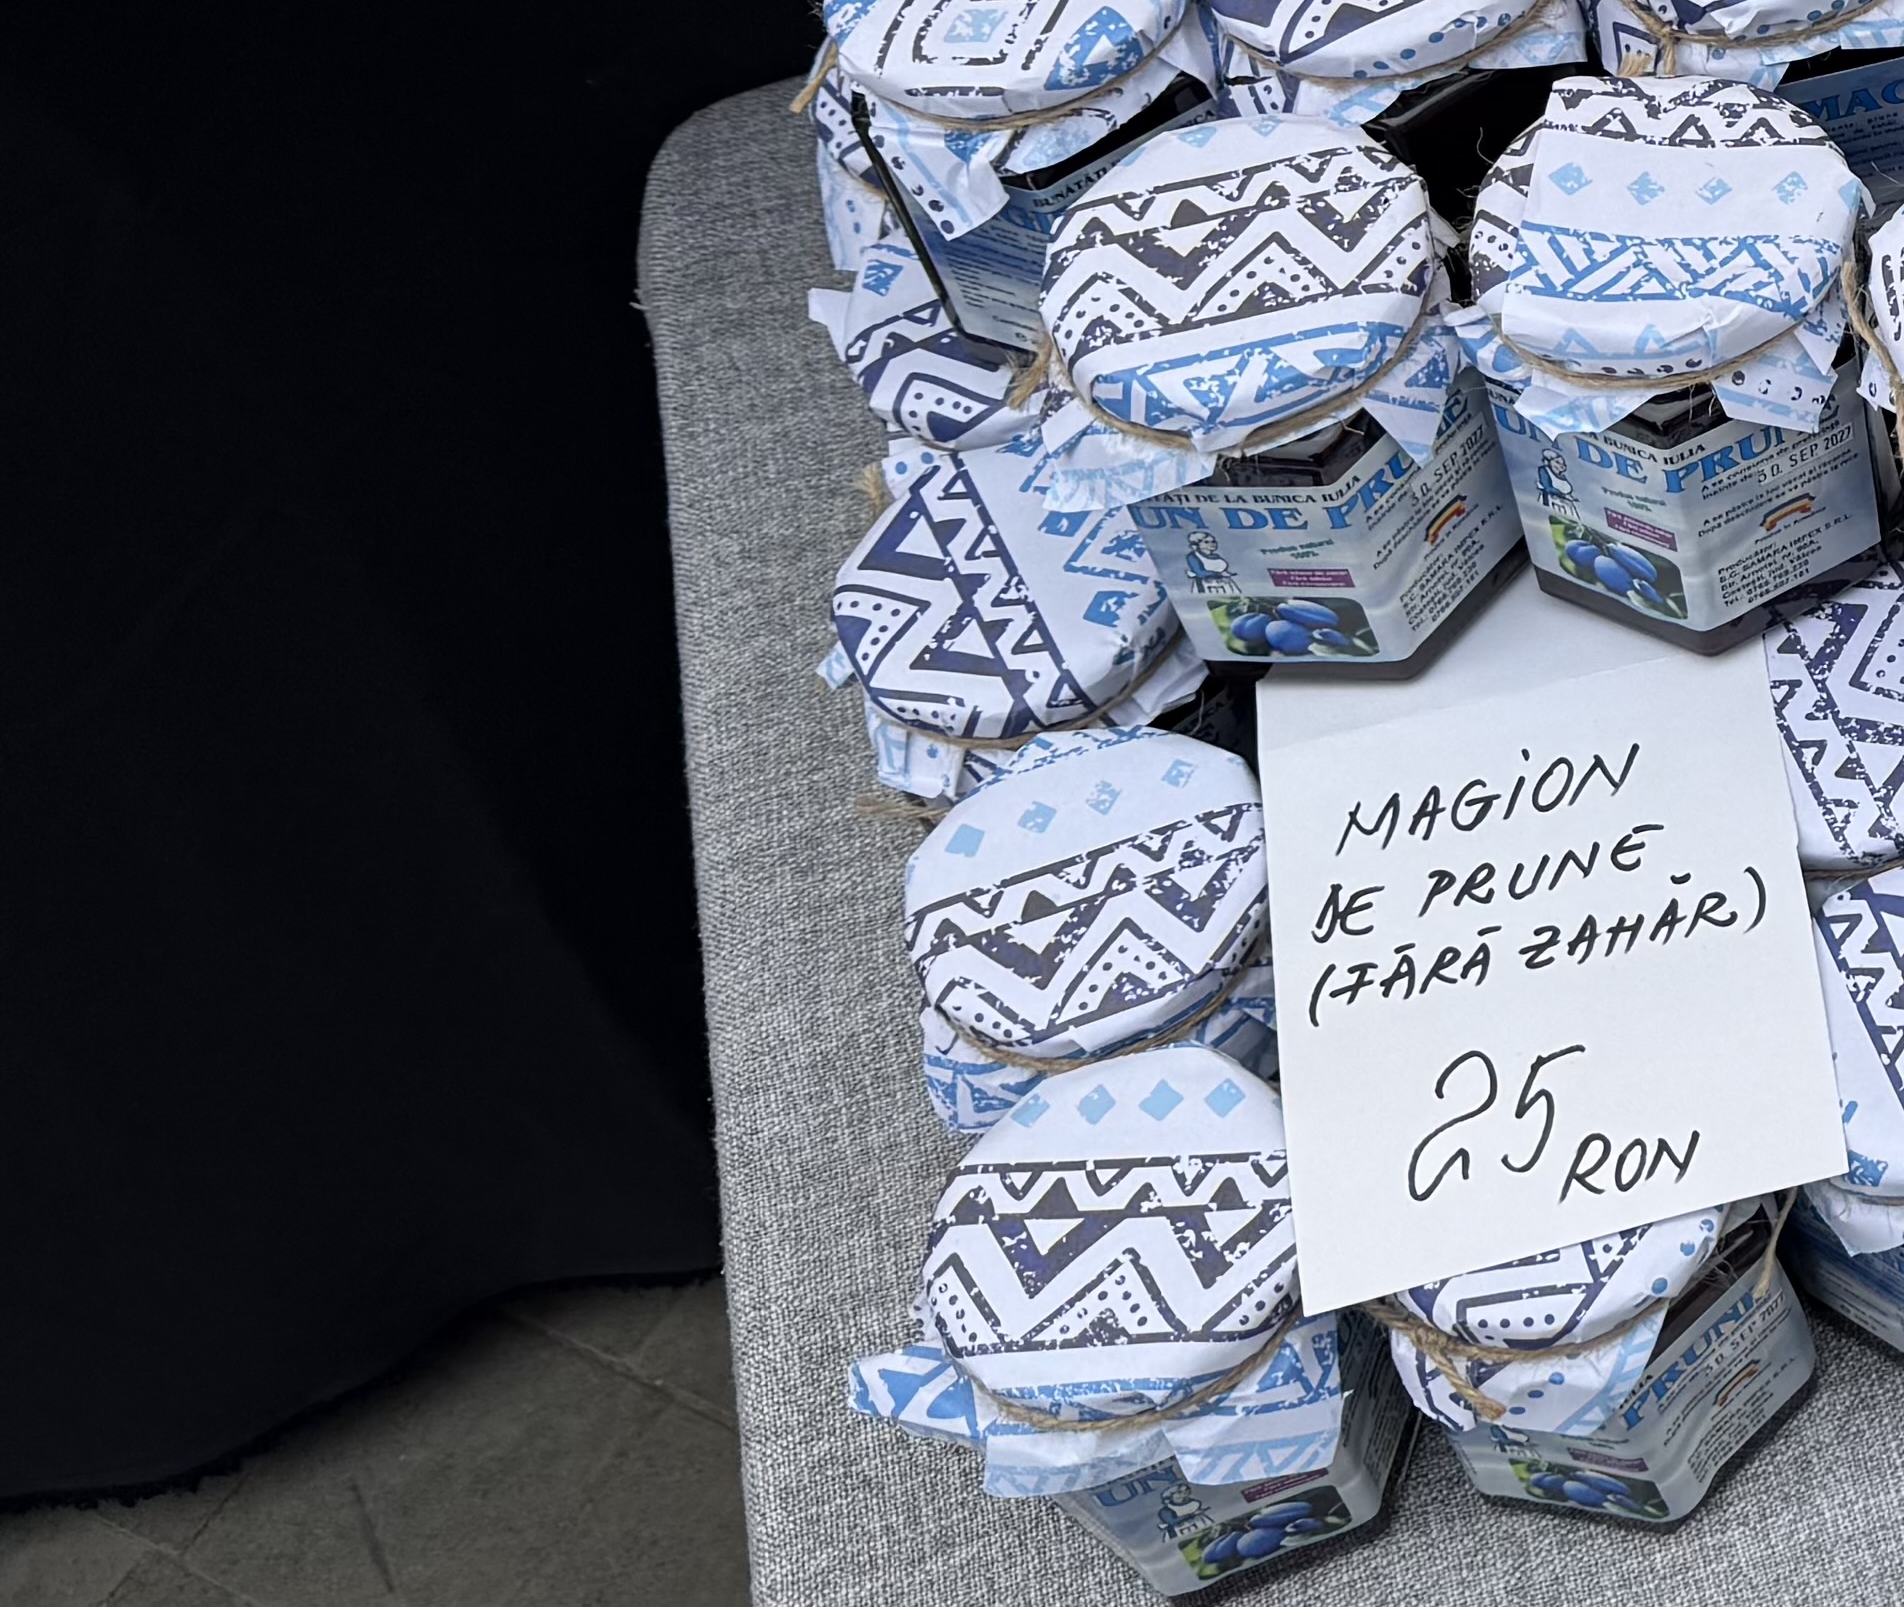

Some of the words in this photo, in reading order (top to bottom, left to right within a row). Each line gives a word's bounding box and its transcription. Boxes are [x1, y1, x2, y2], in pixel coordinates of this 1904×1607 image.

[1578, 436, 1648, 484] DE
[1218, 506, 1309, 530] DE
[1311, 883, 1384, 945] DE
[1418, 822, 1665, 919] PRUNE
[1407, 1044, 1587, 1203] 25
[1558, 1128, 1702, 1207] RON
